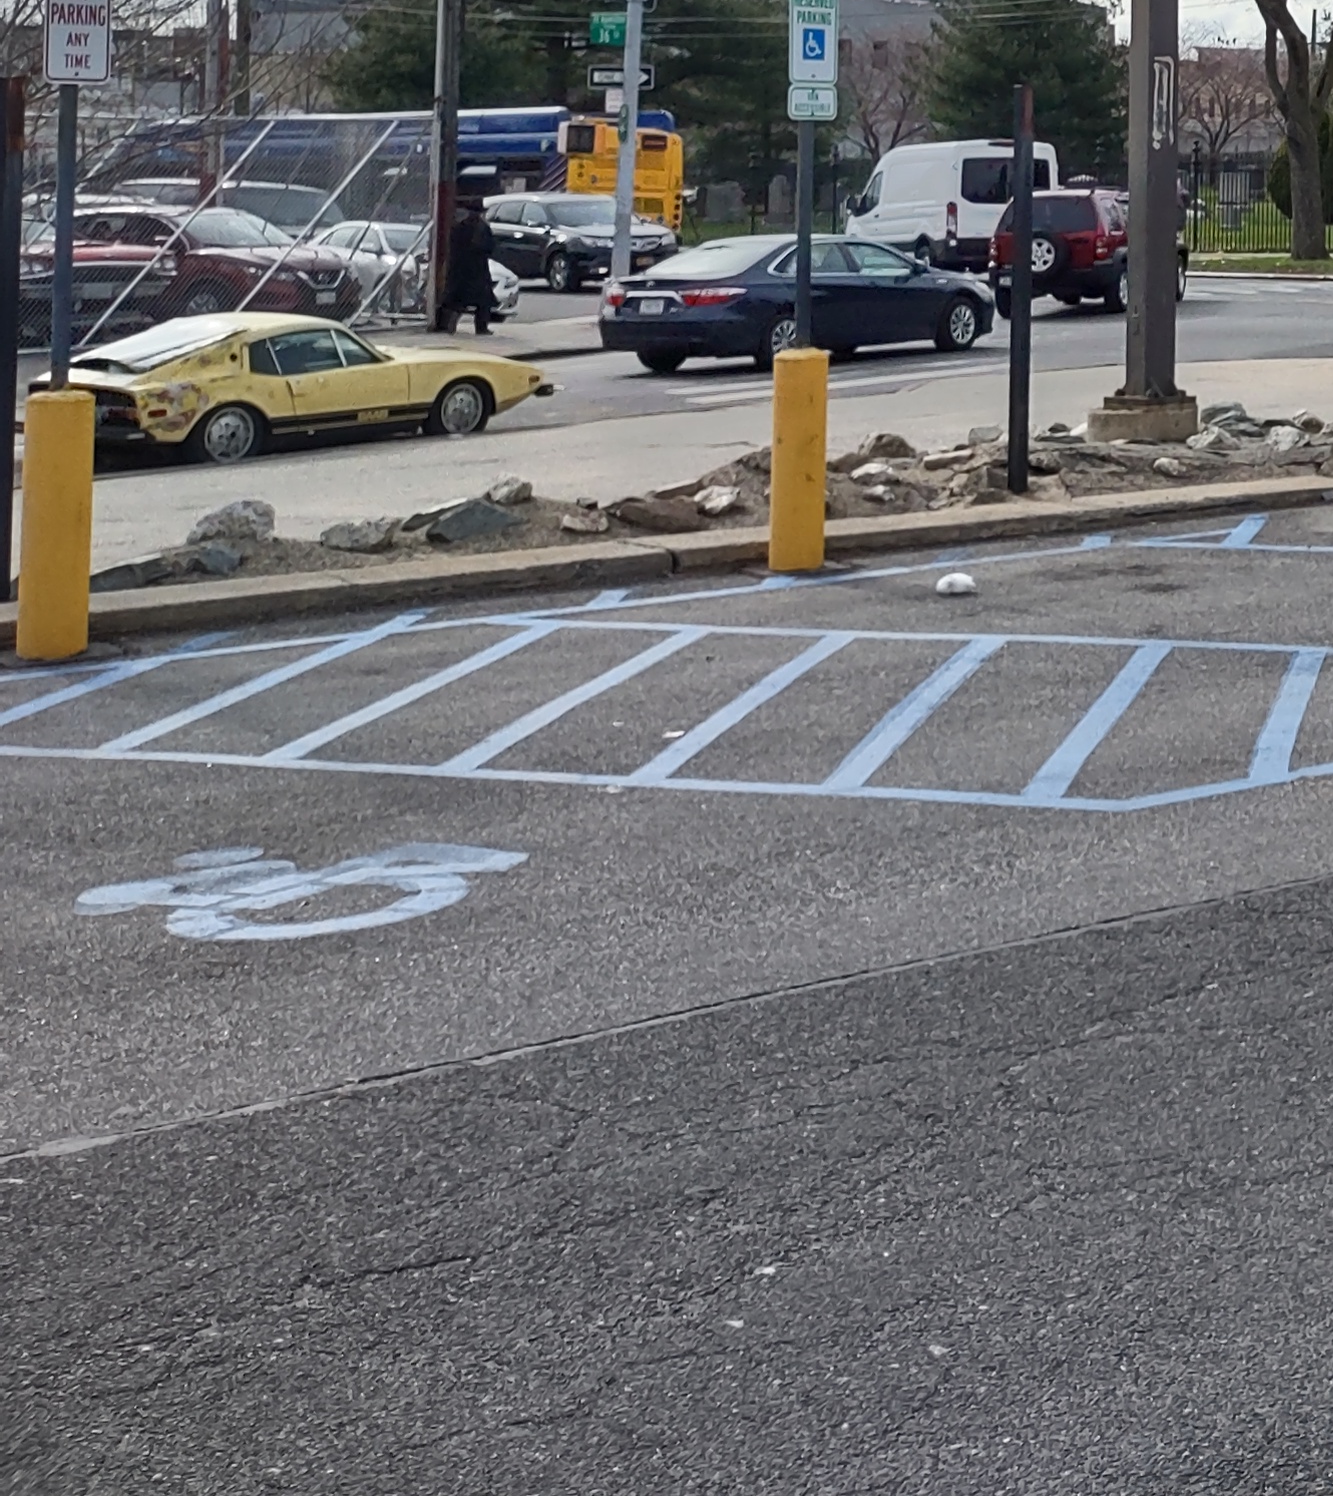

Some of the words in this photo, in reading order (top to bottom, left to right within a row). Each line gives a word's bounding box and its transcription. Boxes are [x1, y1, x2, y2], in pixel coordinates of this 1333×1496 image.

[51, 3, 106, 26] PARKING
[797, 10, 832, 25] PARKING
[66, 32, 90, 47] ANY
[64, 54, 91, 69] TIME
